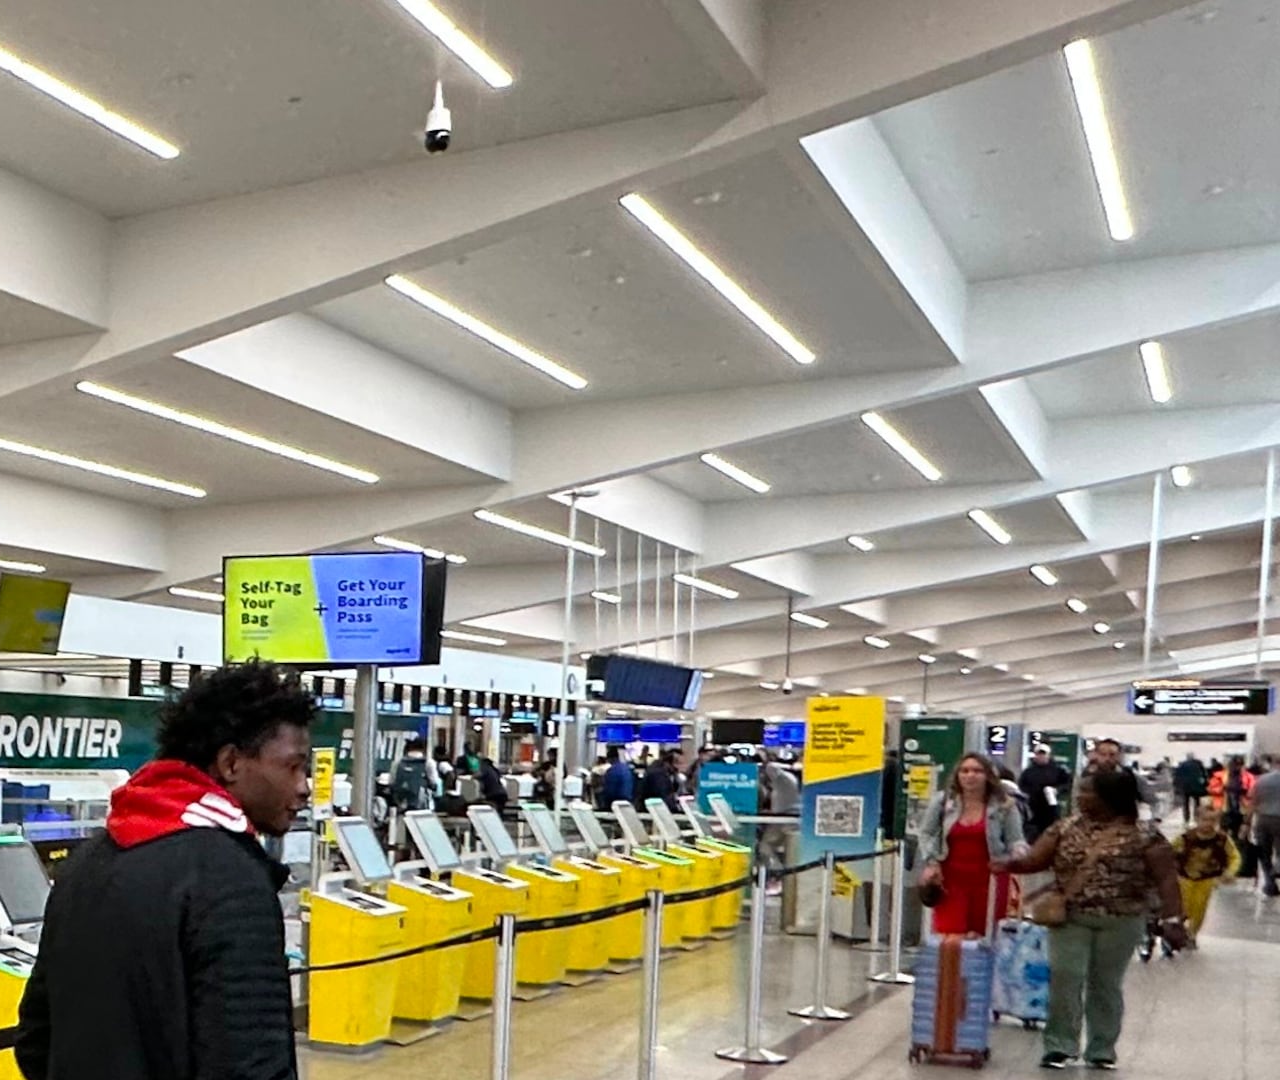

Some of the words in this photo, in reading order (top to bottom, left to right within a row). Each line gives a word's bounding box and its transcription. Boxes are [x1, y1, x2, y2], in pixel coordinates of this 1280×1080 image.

[240, 581, 302, 596] Self-Tag
[337, 579, 365, 592] Get
[368, 579, 406, 592] Your
[240, 598, 275, 609] Your
[337, 594, 408, 609] Boarding
[241, 613, 269, 627] Bag
[337, 611, 373, 623] Pass
[991, 726, 1006, 743] 2
